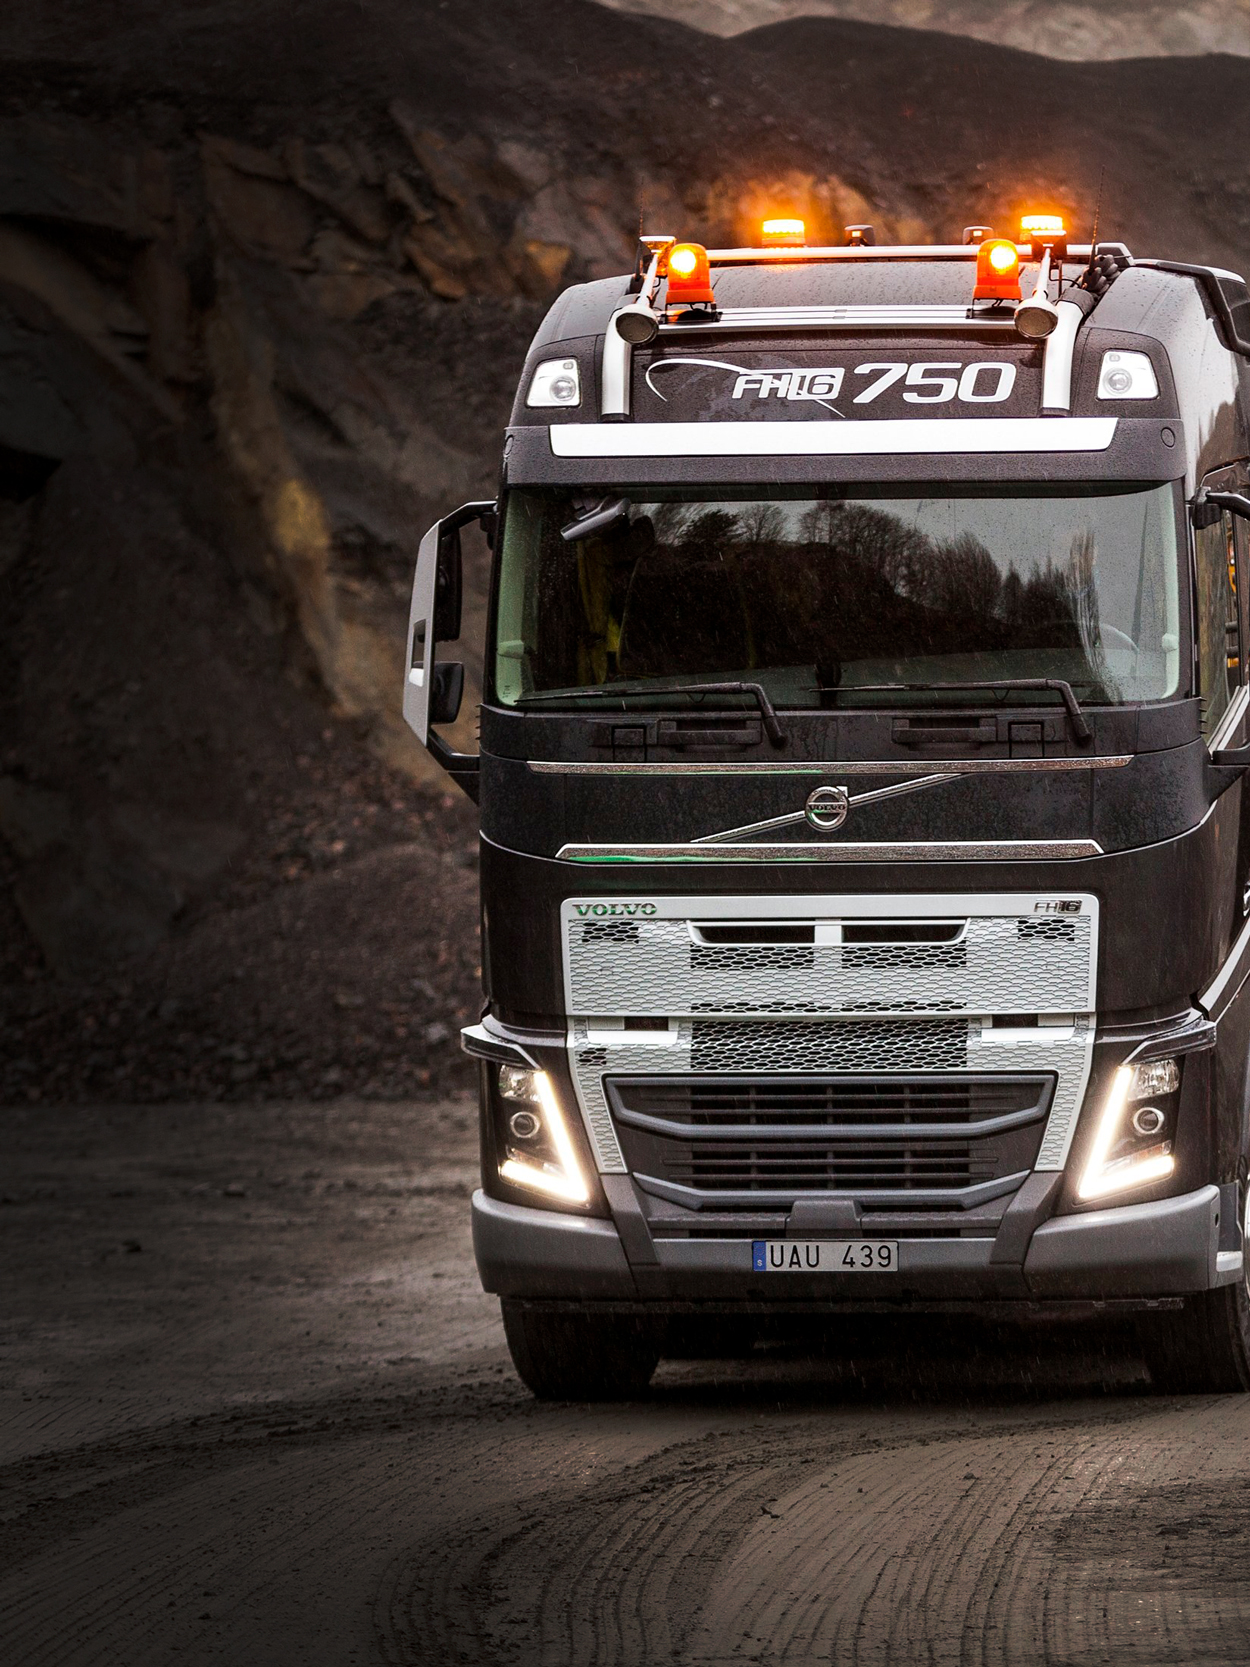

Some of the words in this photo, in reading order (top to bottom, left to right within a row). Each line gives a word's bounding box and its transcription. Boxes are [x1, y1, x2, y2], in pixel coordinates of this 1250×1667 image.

[731, 367, 845, 401] FH16
[853, 362, 1016, 404] 750
[808, 803, 846, 811] VOLVO
[572, 903, 657, 916] VOLVO
[1034, 900, 1082, 914] FH16
[757, 1259, 763, 1267] S
[770, 1245, 820, 1268] UAU
[842, 1245, 892, 1268] 439
